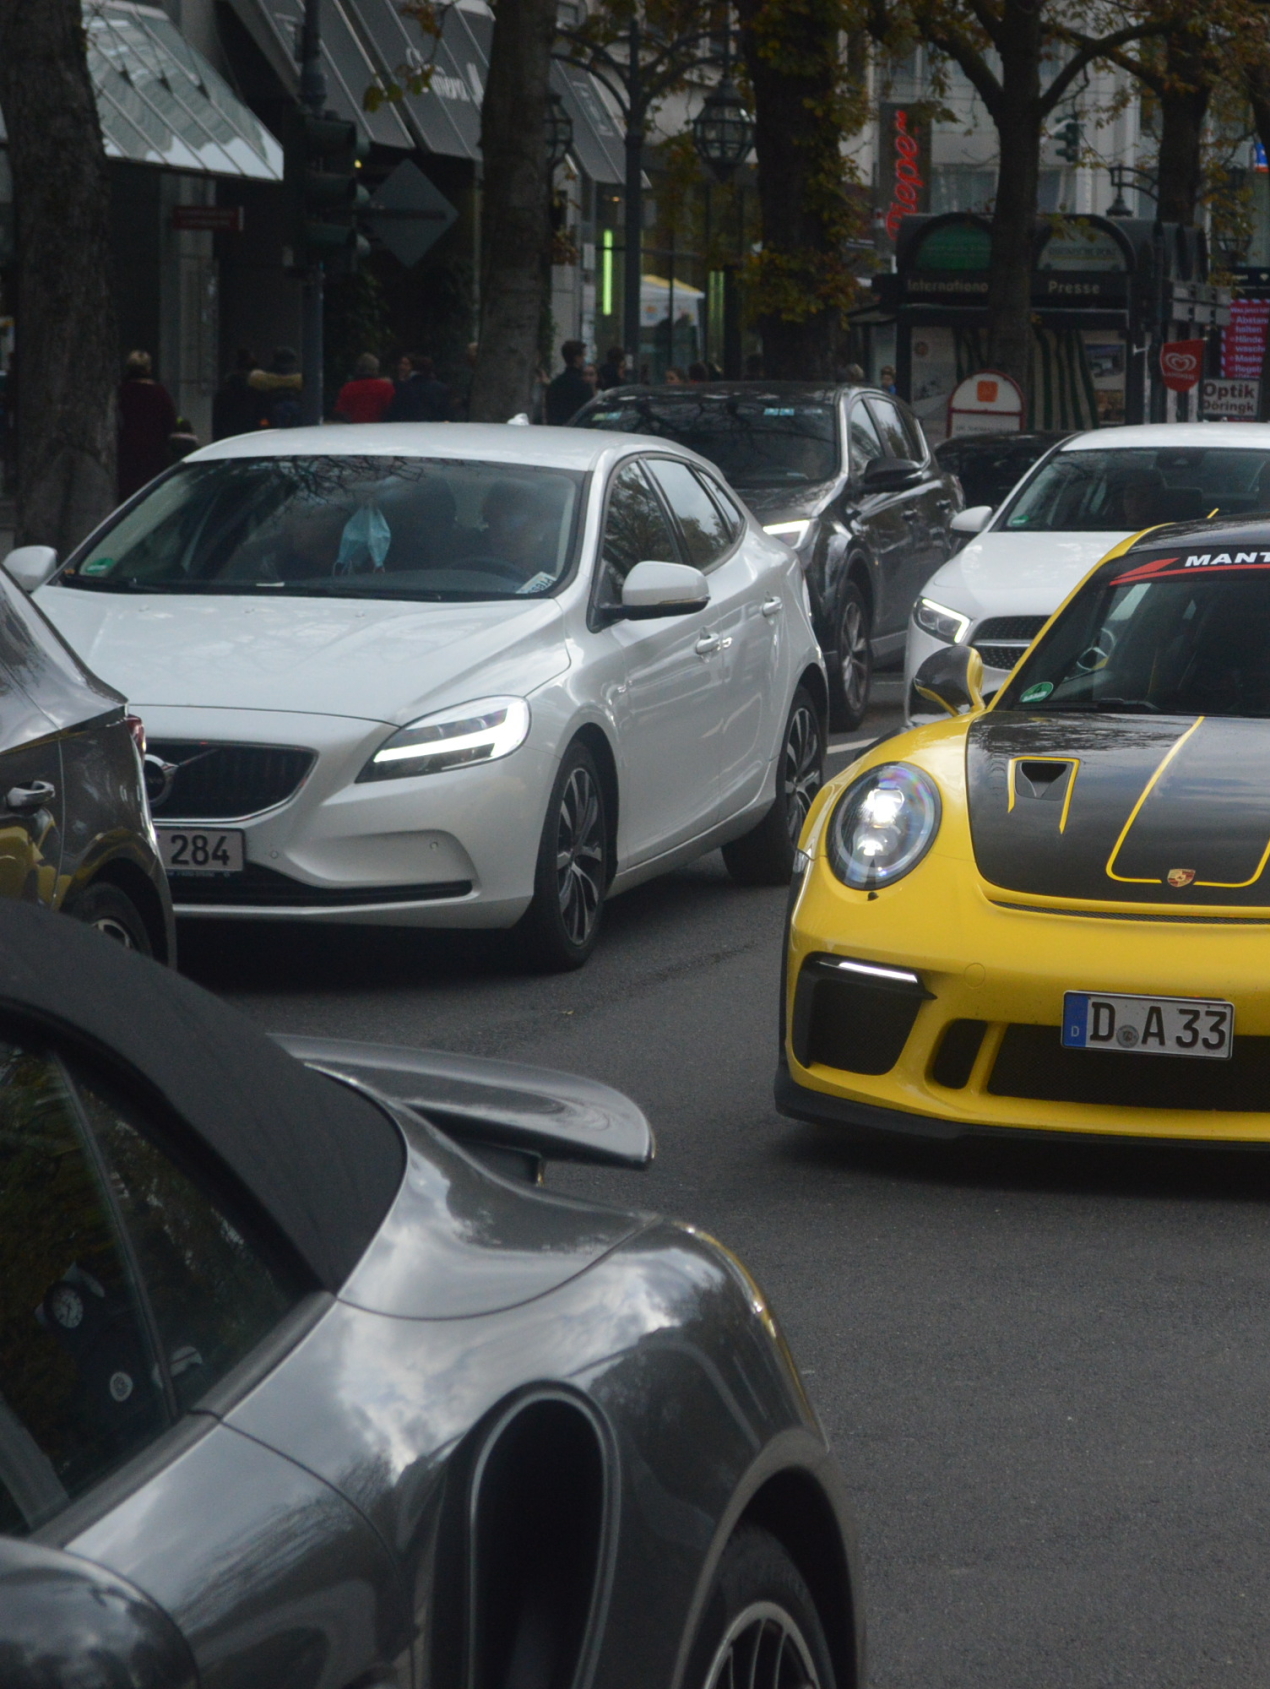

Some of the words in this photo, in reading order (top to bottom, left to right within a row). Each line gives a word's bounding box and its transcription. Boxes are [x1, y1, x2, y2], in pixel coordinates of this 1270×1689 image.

[1047, 280, 1101, 294] Presse
[1203, 383, 1255, 399] Optik
[169, 834, 230, 867] 284
[1089, 1001, 1116, 1042] D
[1141, 1005, 1166, 1046] A
[1175, 1008, 1228, 1050] 33
